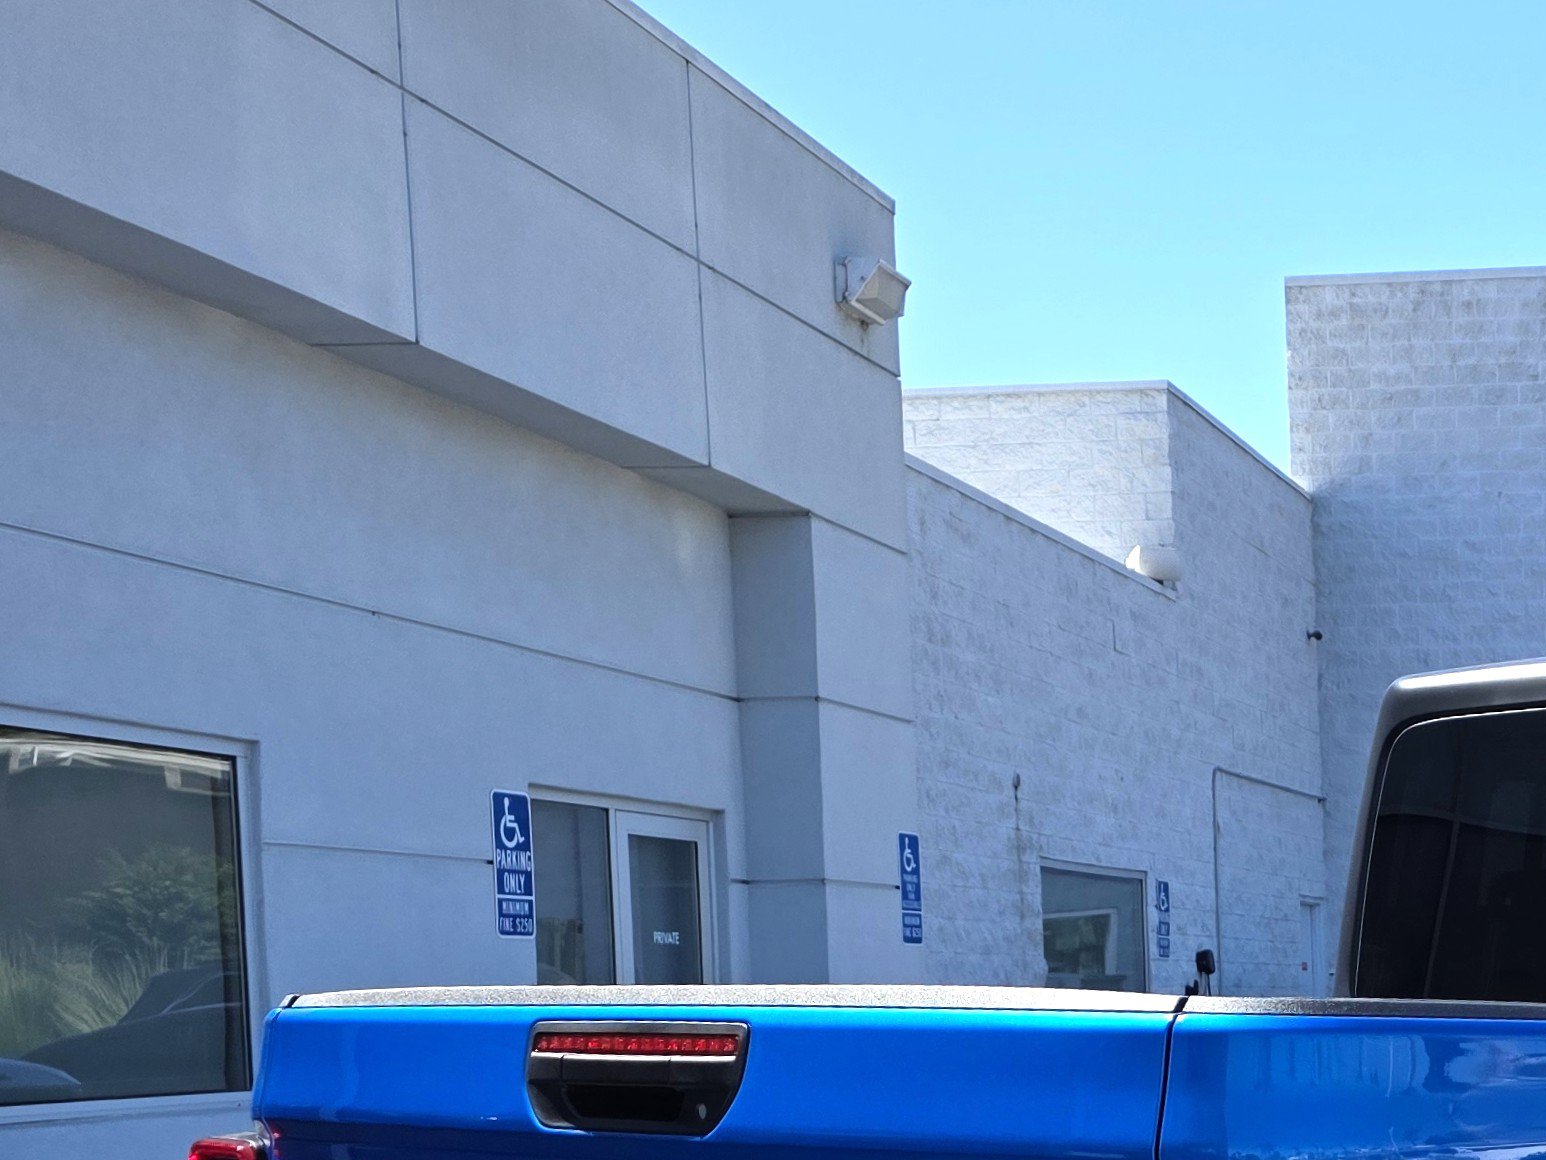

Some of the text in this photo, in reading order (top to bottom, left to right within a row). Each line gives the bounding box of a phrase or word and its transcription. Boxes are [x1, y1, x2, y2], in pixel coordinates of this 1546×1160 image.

[496, 849, 532, 872] PARKING
[504, 872, 525, 893] ONLY
[502, 901, 530, 915] MINIMUM
[499, 917, 533, 932] FINE $250
[653, 931, 680, 944] PRIVATE
